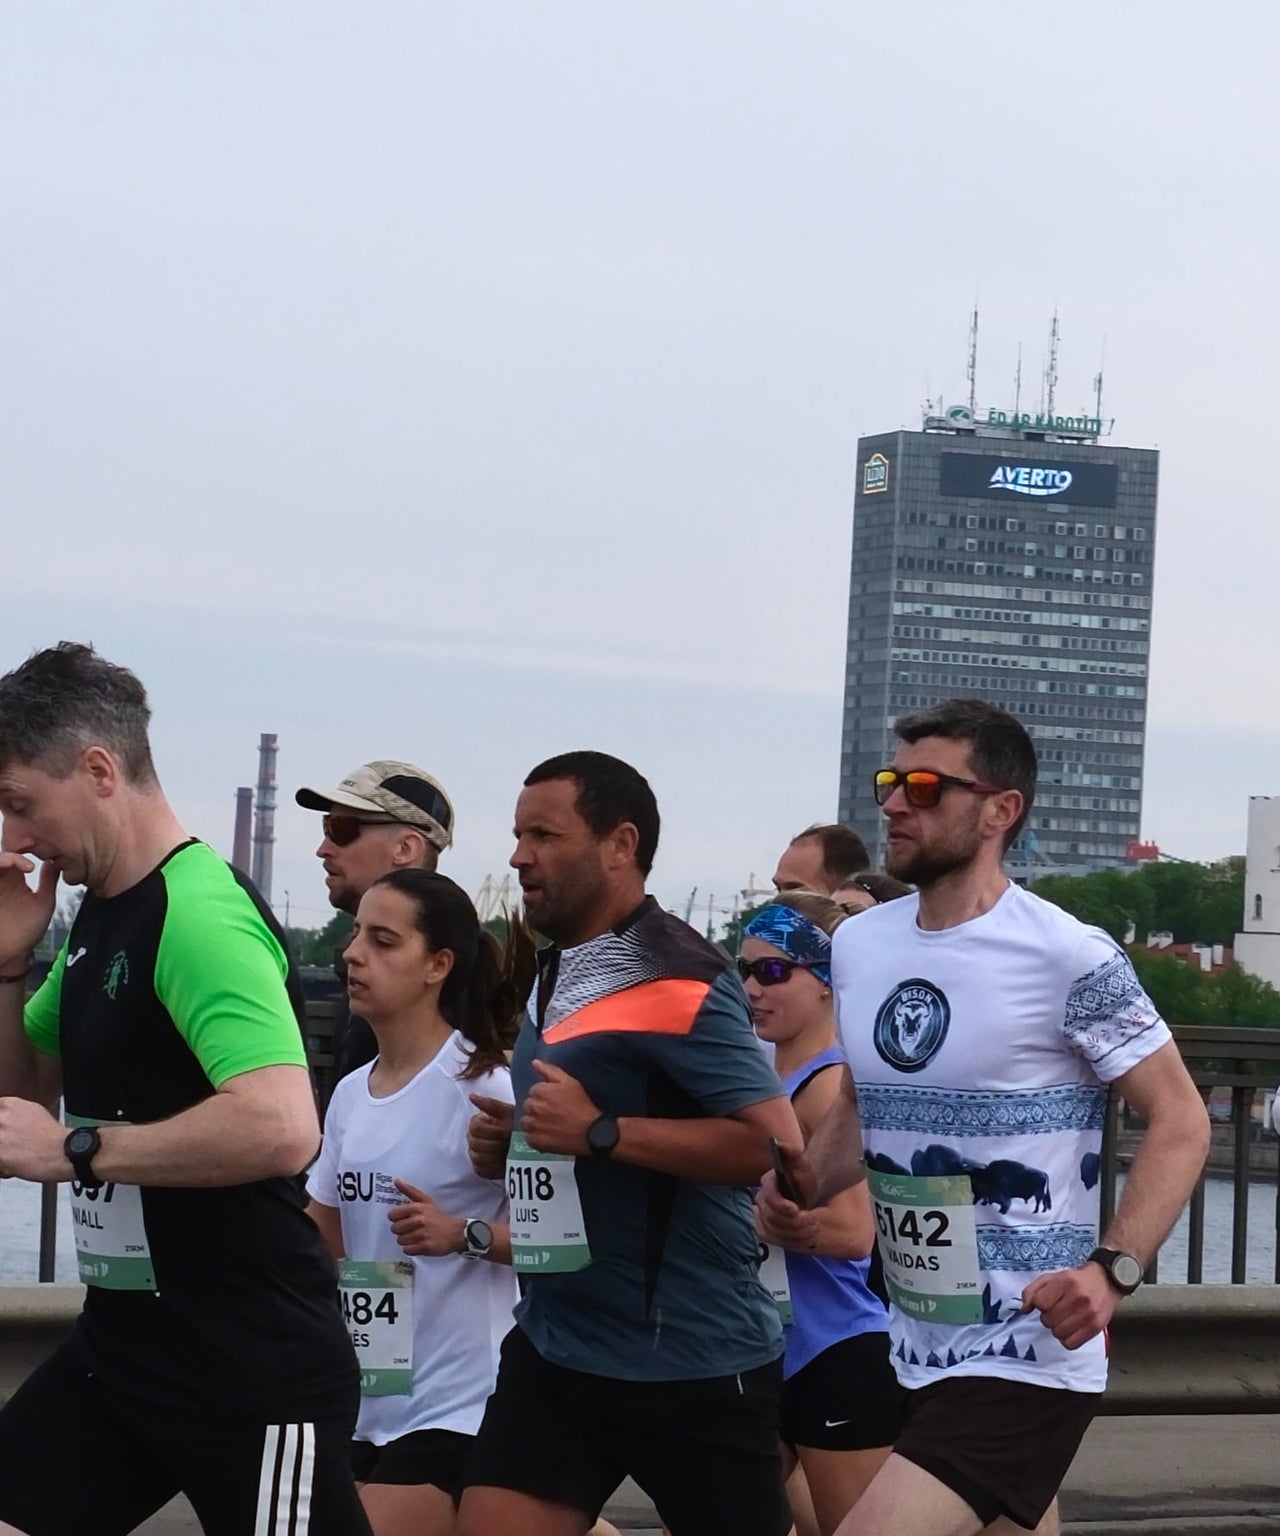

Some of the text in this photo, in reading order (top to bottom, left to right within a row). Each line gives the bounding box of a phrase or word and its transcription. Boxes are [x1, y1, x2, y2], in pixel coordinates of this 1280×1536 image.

[989, 466, 1073, 490] AVERTO
[900, 989, 934, 1004] BISON
[509, 1166, 554, 1201] 6118
[72, 1206, 104, 1230] NIALL
[516, 1209, 539, 1223] LUIS
[875, 1201, 952, 1247] 6142
[887, 1247, 940, 1271] VAIDAS
